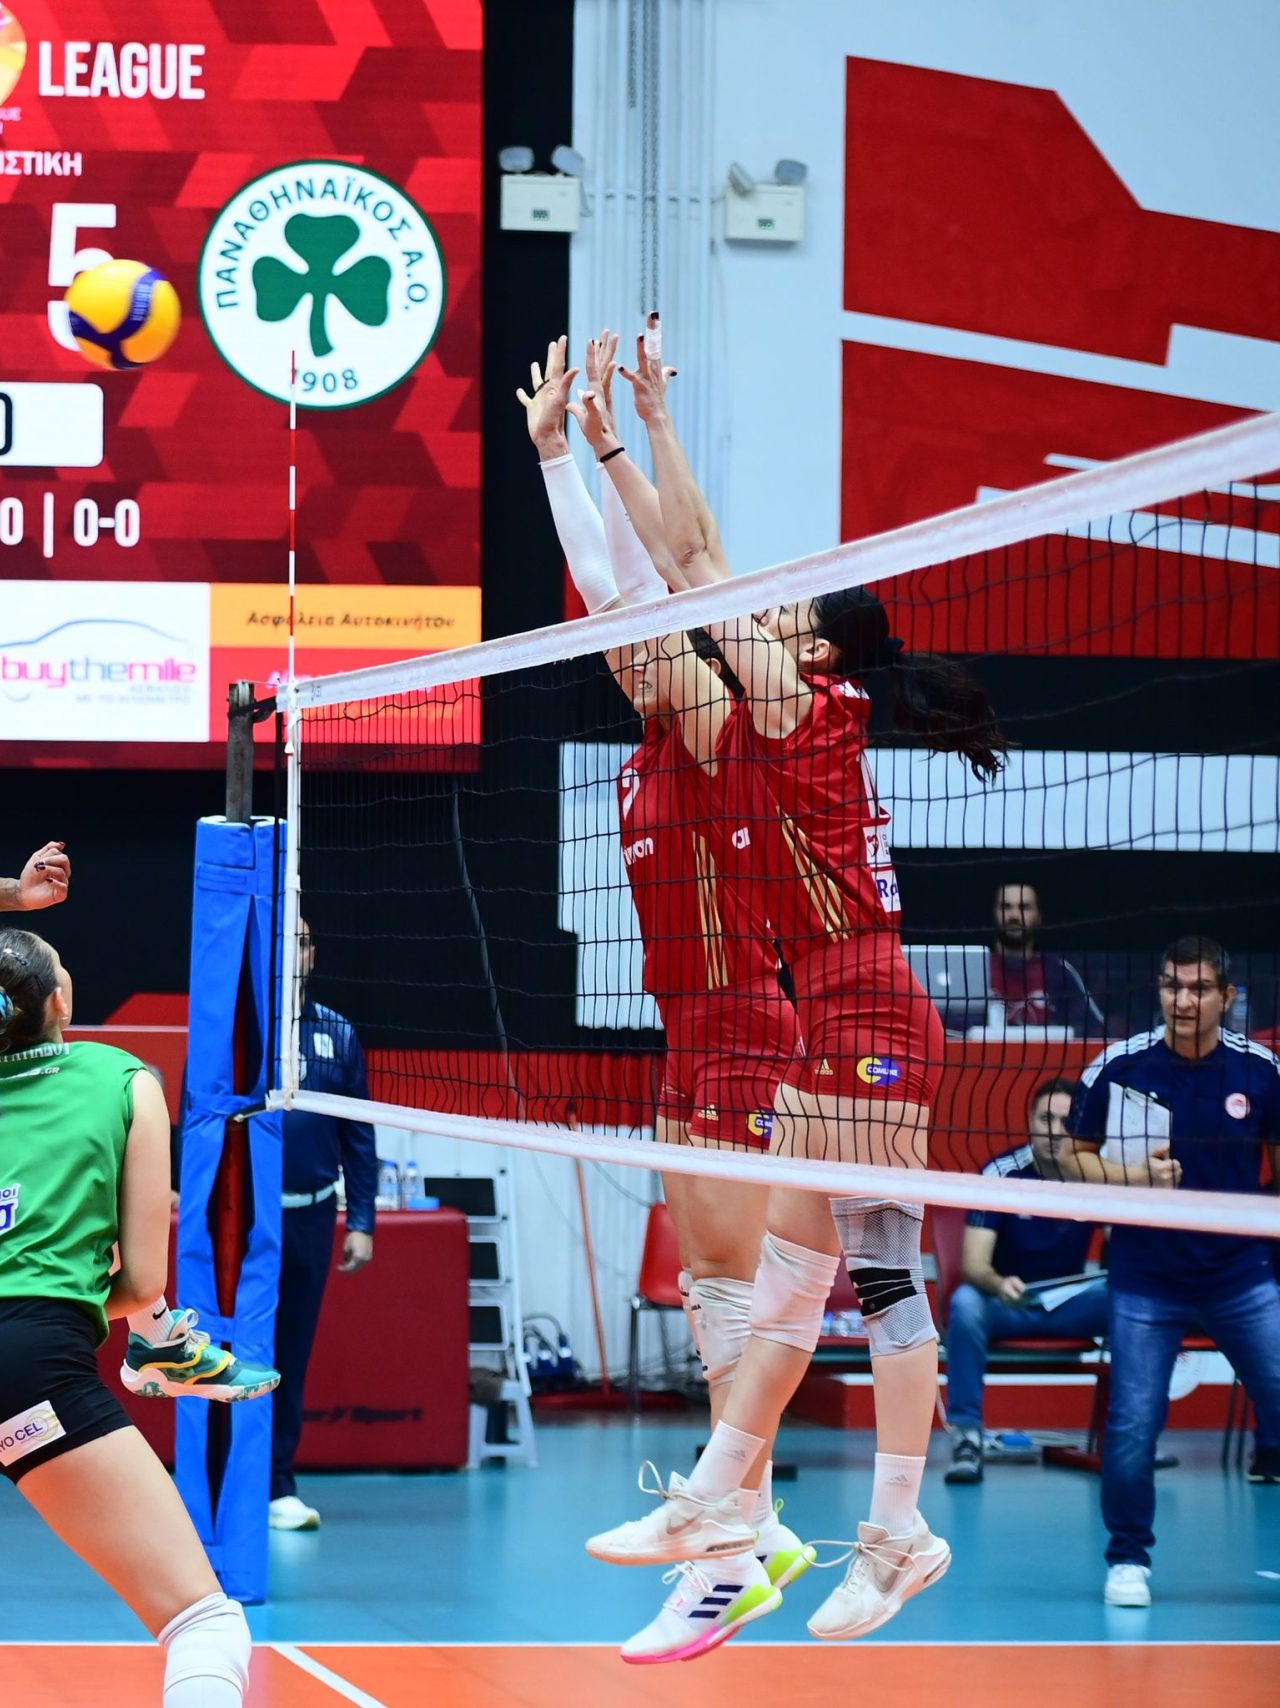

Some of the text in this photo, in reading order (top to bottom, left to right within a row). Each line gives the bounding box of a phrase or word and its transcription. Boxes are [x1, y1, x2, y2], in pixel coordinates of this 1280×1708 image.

[38, 40, 206, 100] LEAGUE
[73, 498, 141, 548] 0-0
[1, 656, 197, 689] buythemile
